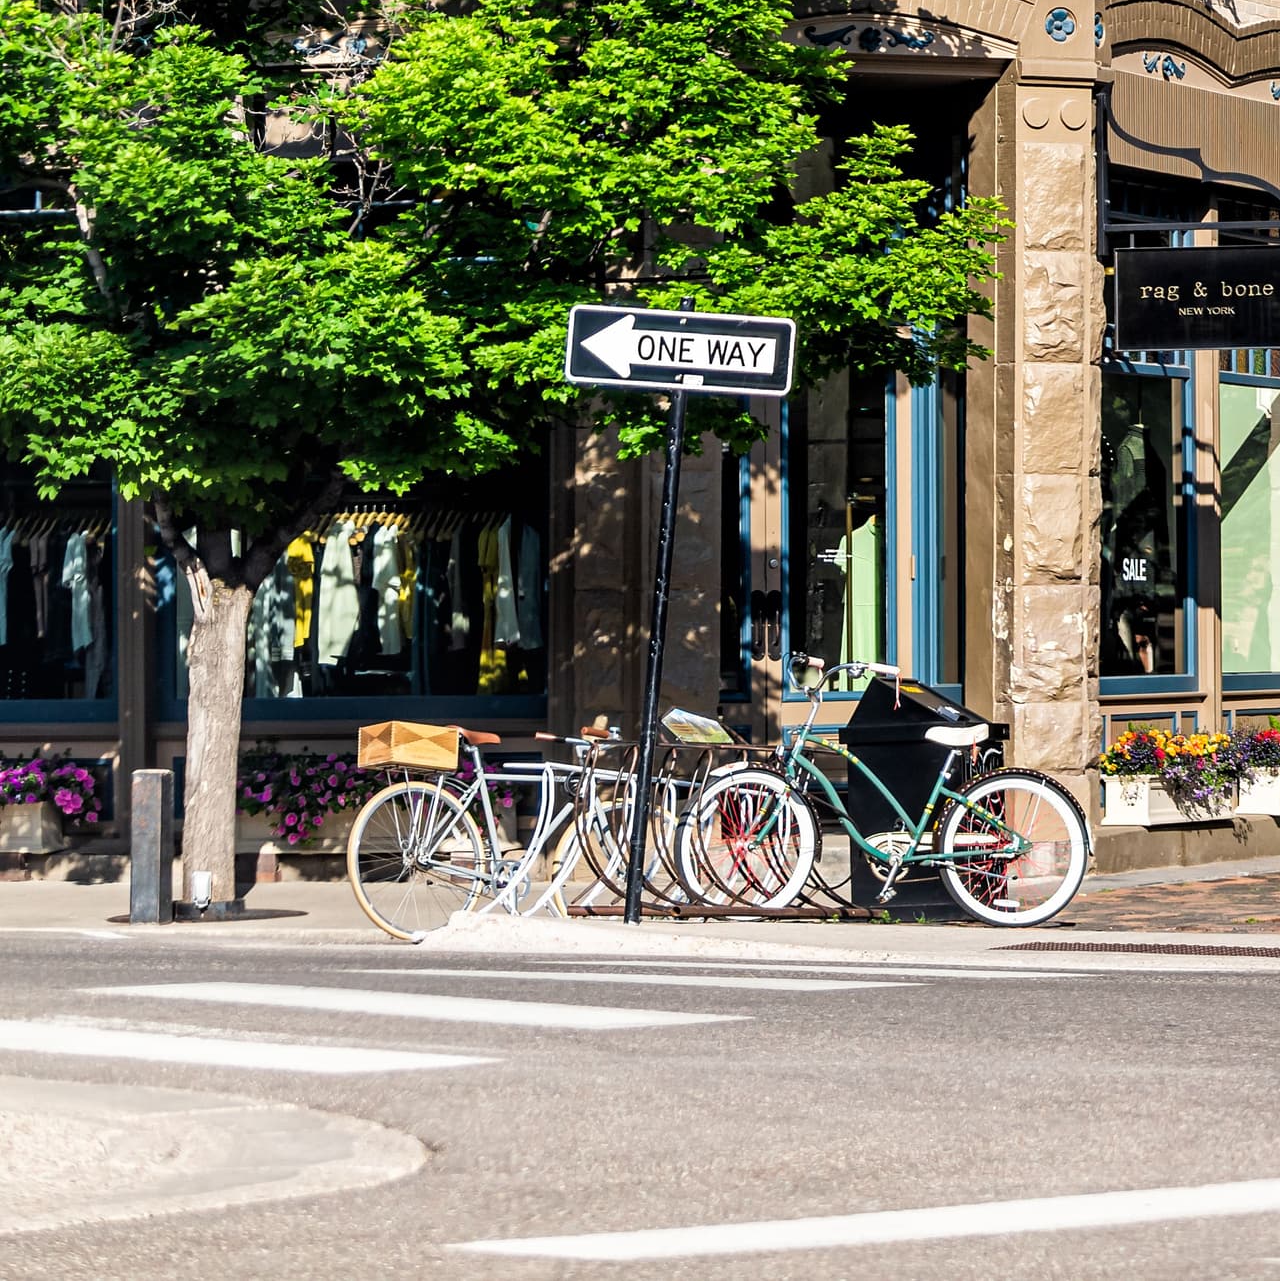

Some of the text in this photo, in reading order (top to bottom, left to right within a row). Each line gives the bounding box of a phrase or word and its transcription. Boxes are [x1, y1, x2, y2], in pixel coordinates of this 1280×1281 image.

[1139, 281, 1274, 301] rag & bone
[1178, 305, 1236, 317] NEW YORK
[637, 335, 767, 368] ONE WAY
[1122, 558, 1147, 581] SALE
